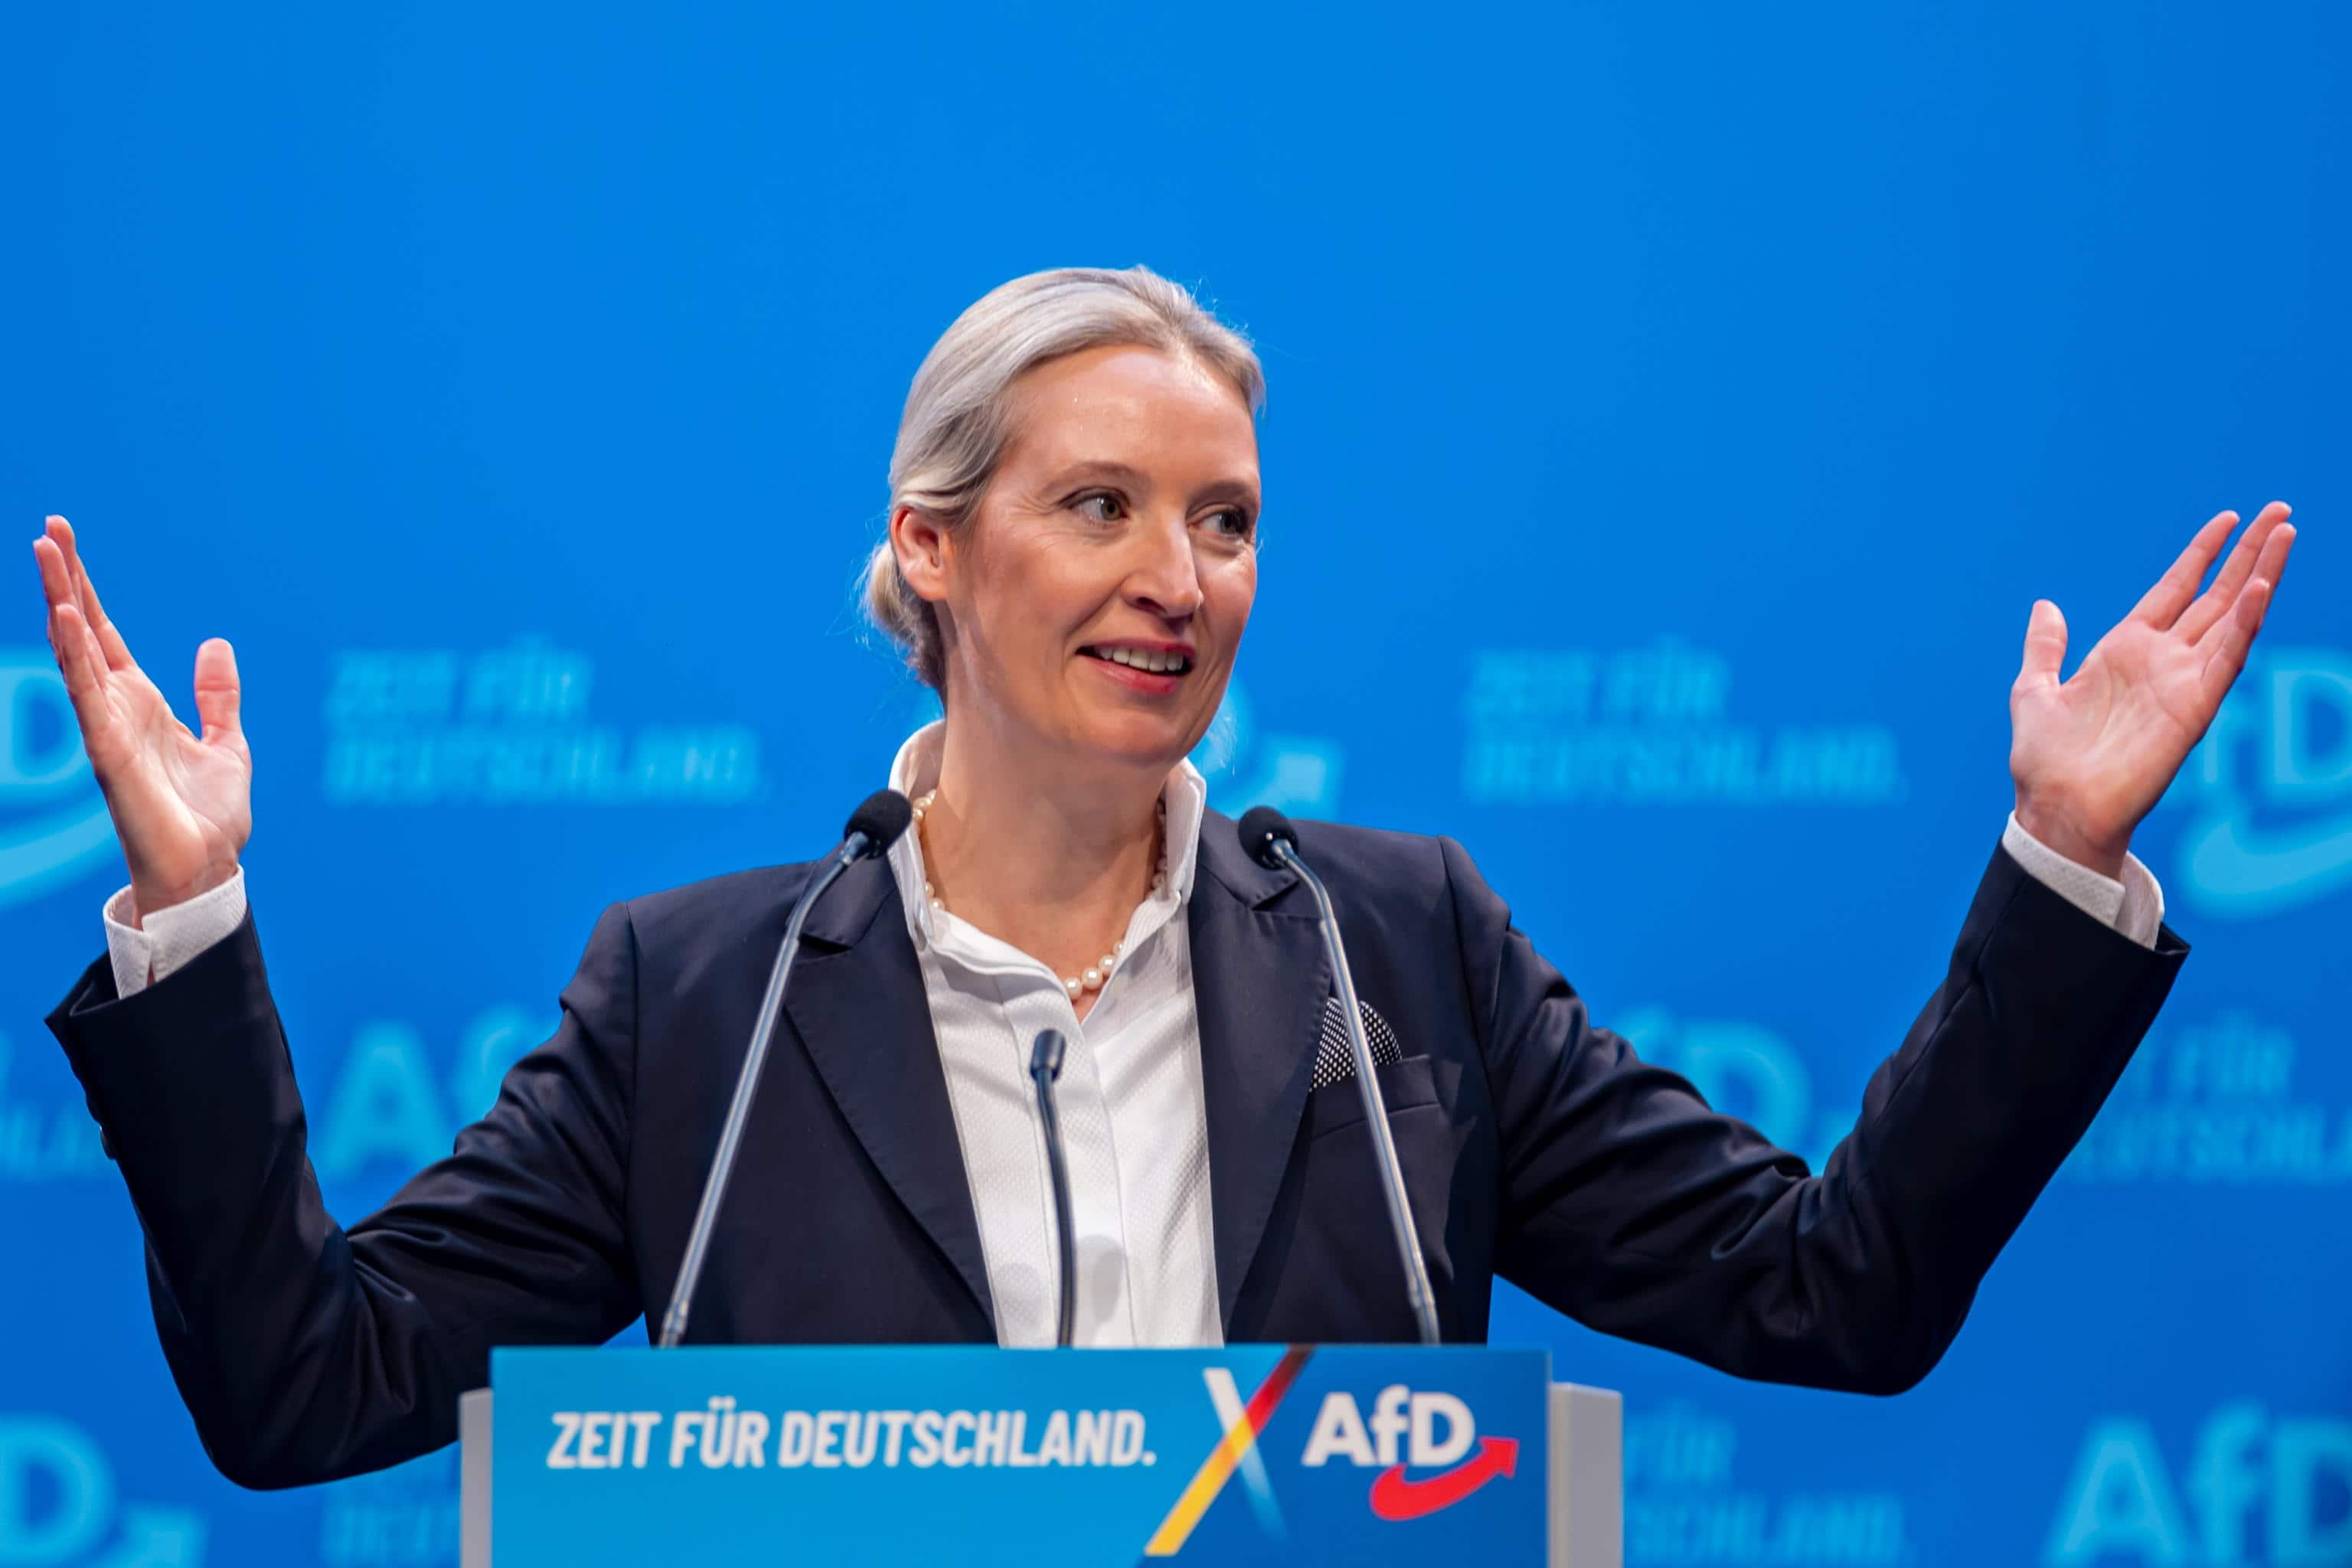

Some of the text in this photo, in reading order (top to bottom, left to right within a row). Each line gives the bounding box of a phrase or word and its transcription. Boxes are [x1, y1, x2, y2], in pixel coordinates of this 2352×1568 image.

[547, 1395, 1158, 1468] ZEIT FÜR DEUTSCHLAND.
[1301, 1383, 1476, 1468] AfD
